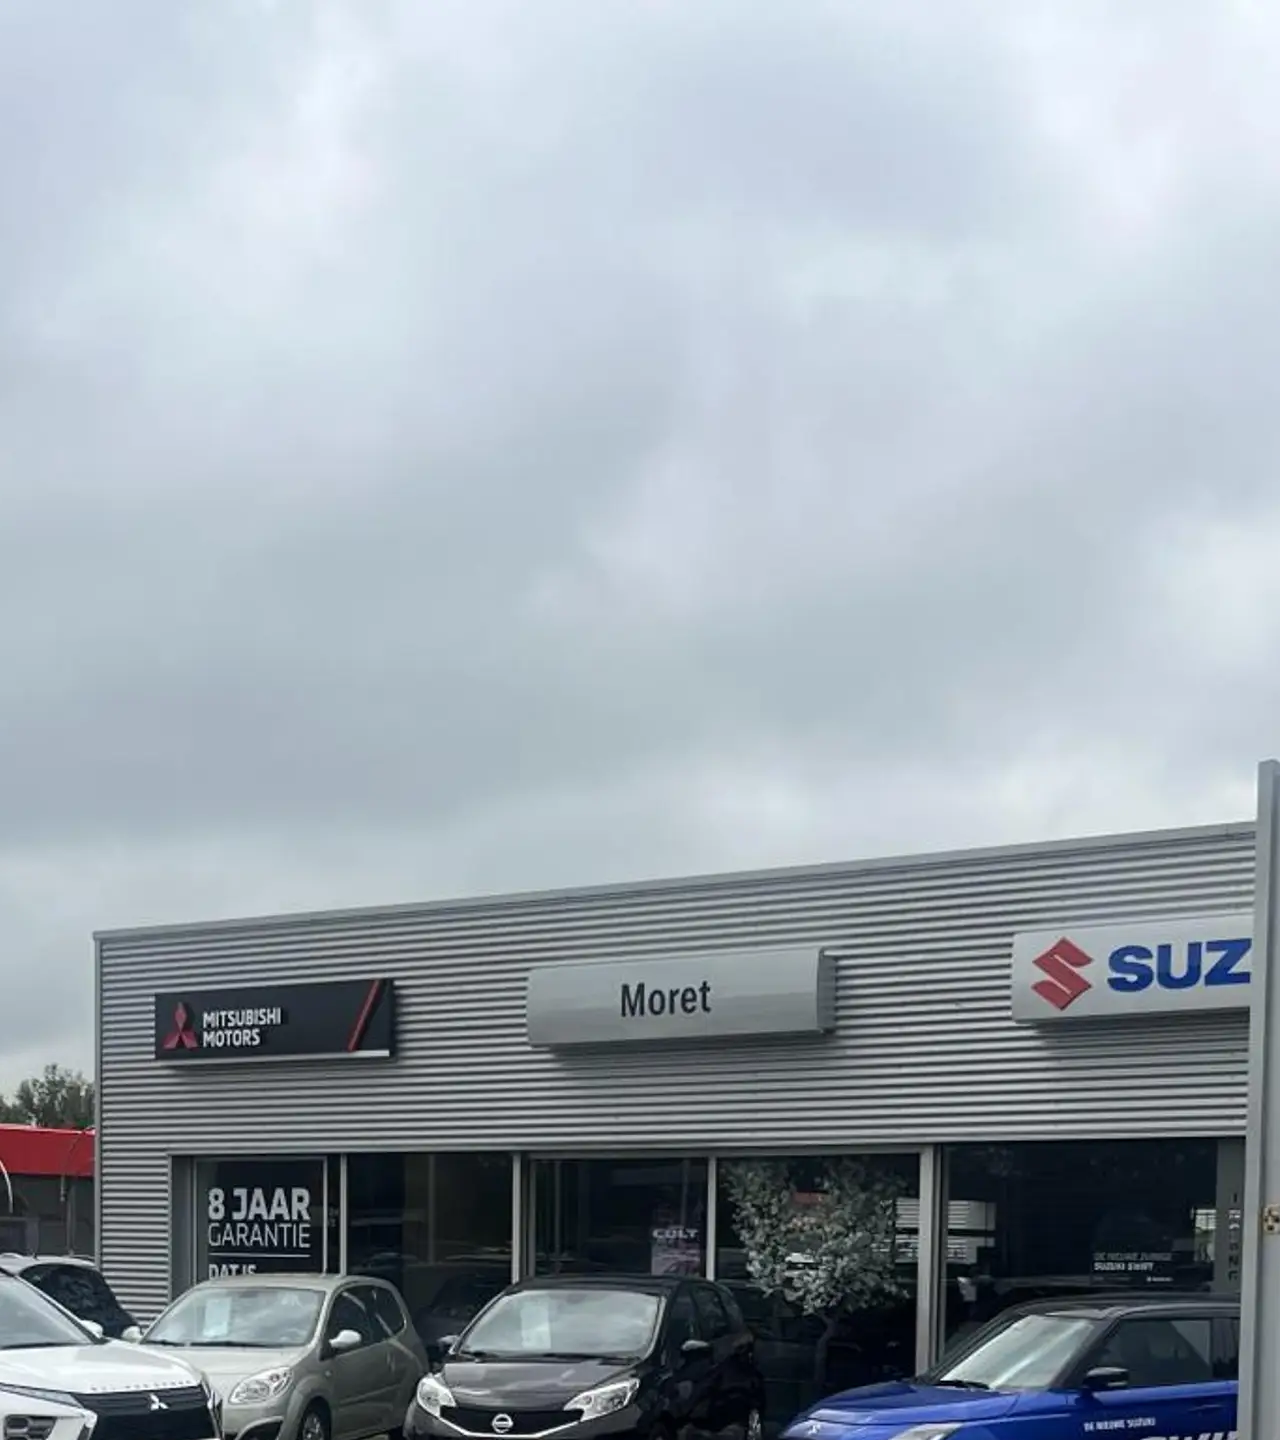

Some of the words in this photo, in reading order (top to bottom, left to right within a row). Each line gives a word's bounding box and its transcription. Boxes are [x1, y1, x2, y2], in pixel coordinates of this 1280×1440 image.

[621, 980, 711, 1018] Moret
[203, 1006, 282, 1028] MITSUBISHI
[203, 1028, 261, 1049] MOTORS
[208, 1187, 225, 1221] 8
[231, 1187, 312, 1221] JAAR
[208, 1222, 312, 1248] GARANTIE
